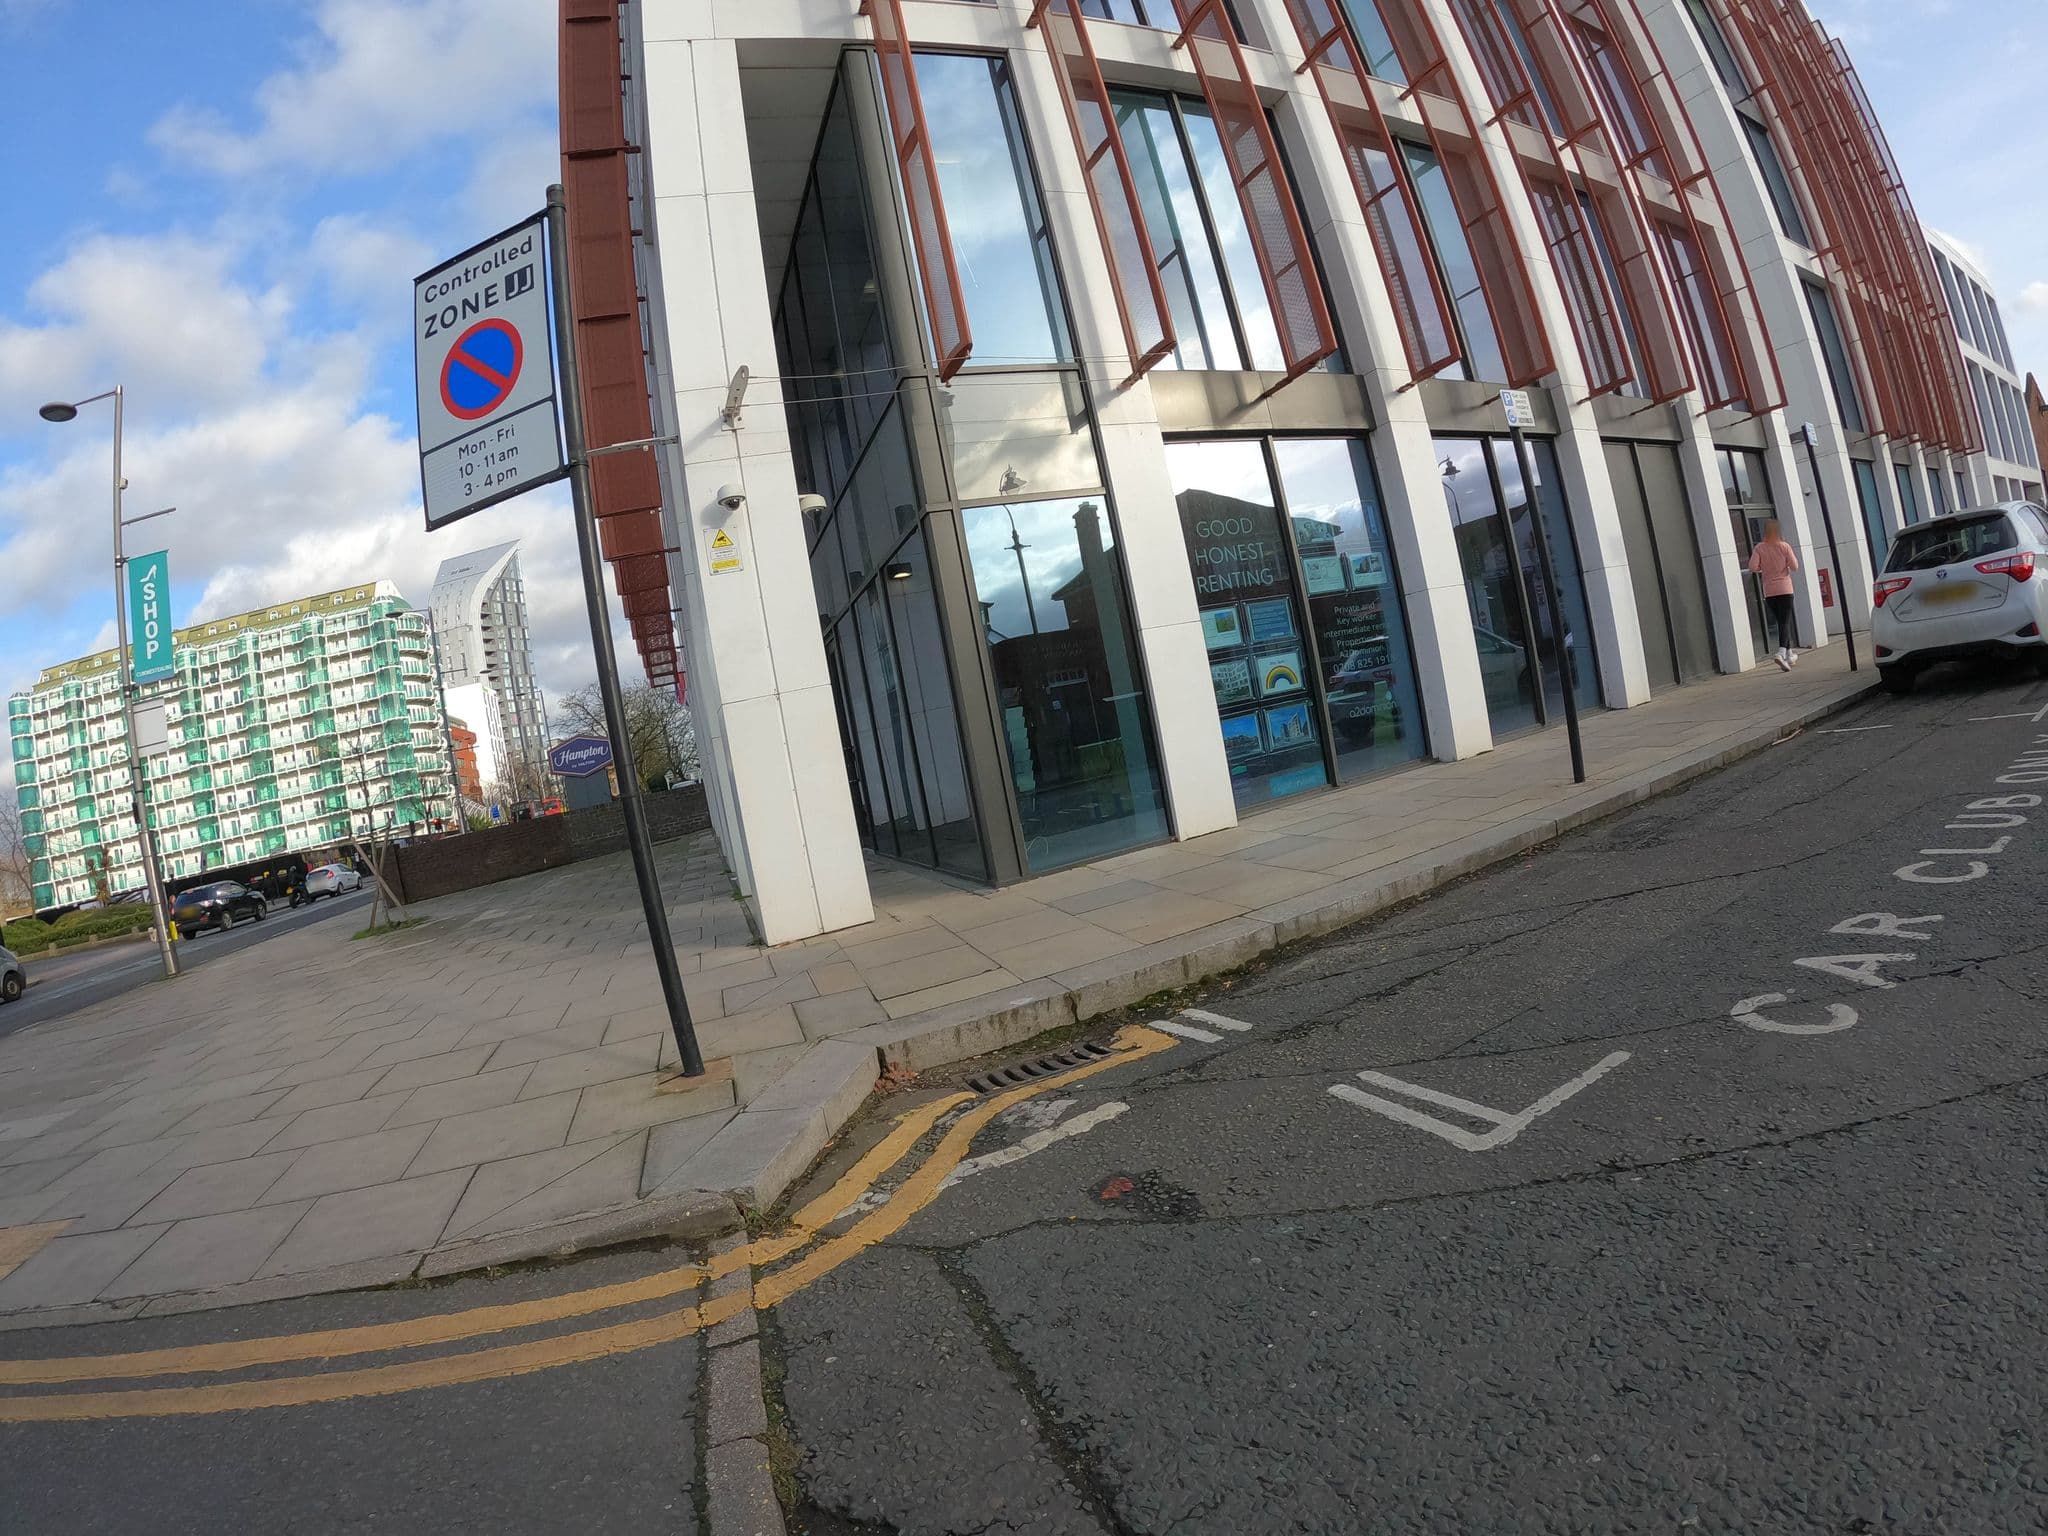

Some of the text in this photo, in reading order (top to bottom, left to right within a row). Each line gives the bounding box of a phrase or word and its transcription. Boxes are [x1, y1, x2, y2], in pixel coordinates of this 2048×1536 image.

[424, 235, 532, 304] Controlled
[424, 265, 533, 339] ZONE JJ
[458, 444, 486, 460] Mon
[497, 424, 514, 443] Fri
[464, 482, 473, 496] 3
[497, 467, 517, 485] pm
[1196, 517, 1253, 538] GOOD
[1195, 542, 1264, 566] HONEST
[1196, 568, 1274, 593] RENTING
[143, 582, 160, 660] SHOP
[1333, 604, 1361, 615] Private
[1336, 617, 1351, 627] Key
[554, 745, 609, 767] Hampton
[1892, 794, 2042, 883] CLUB
[1730, 912, 1944, 1034] CAR
